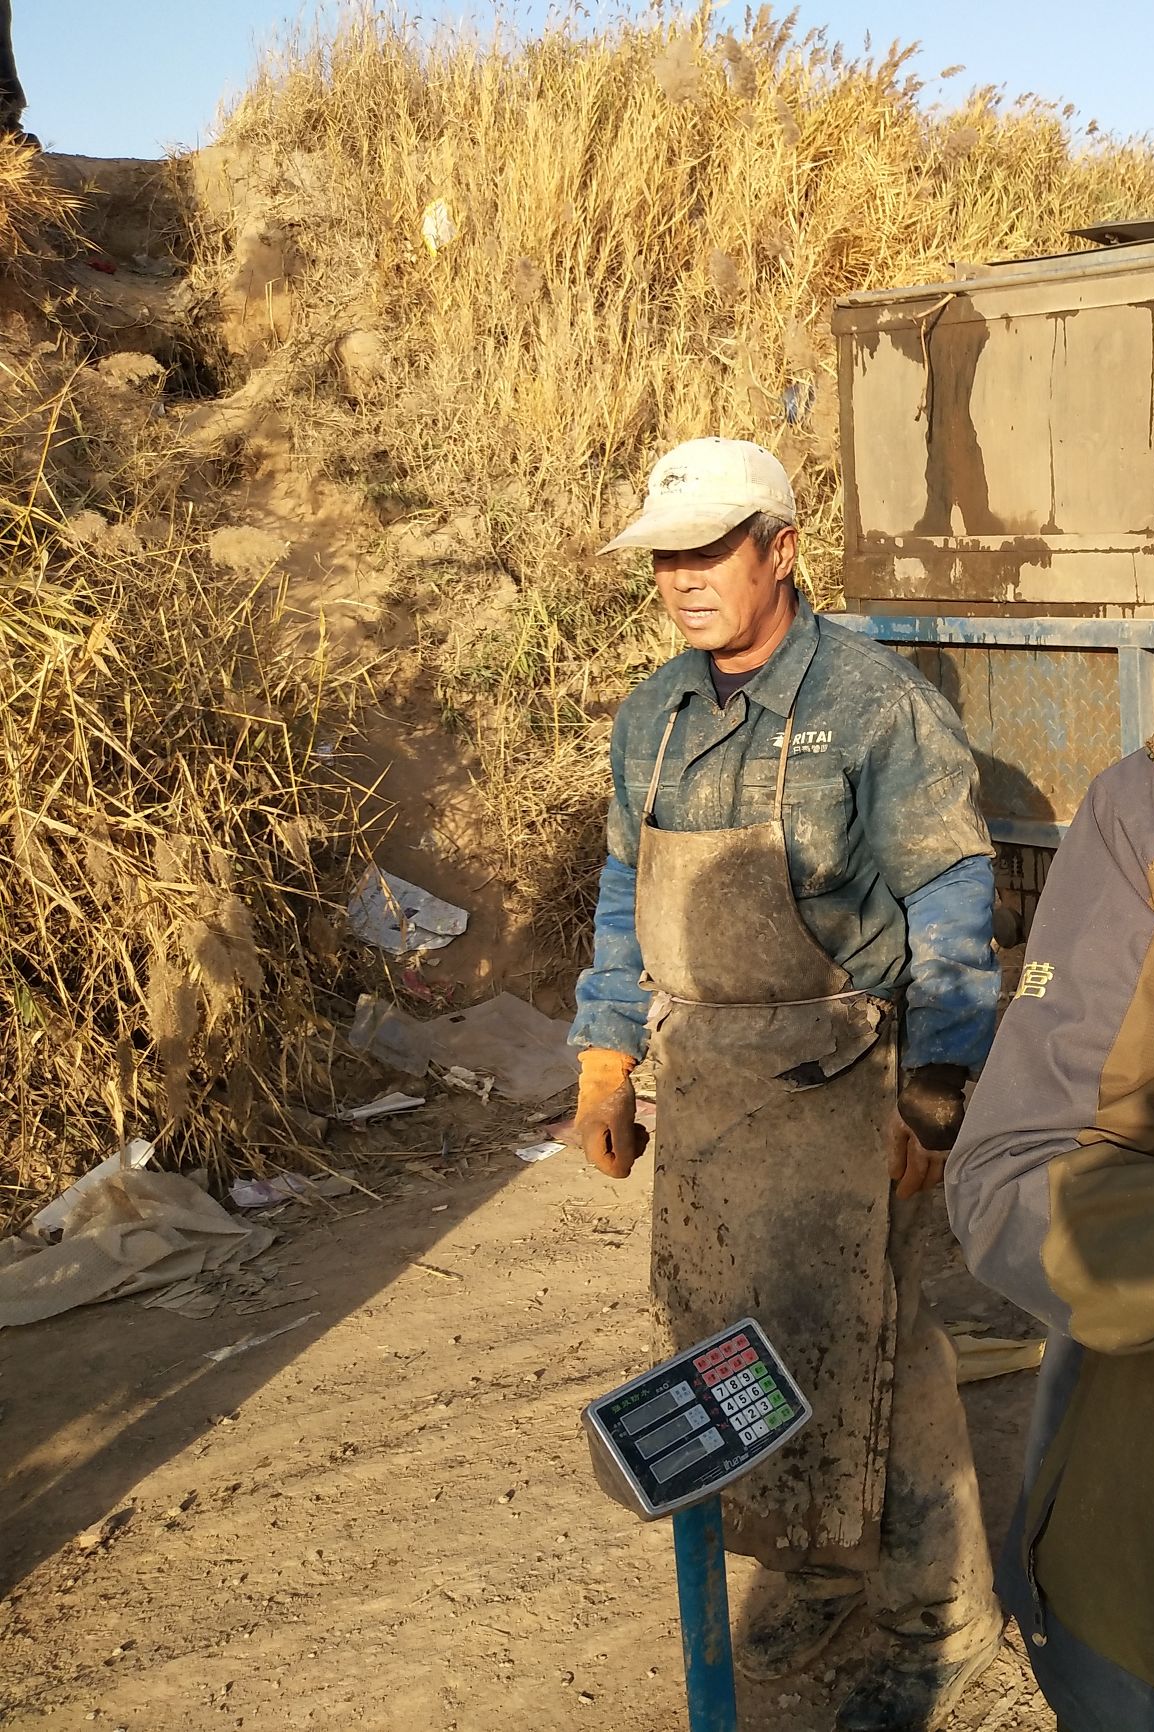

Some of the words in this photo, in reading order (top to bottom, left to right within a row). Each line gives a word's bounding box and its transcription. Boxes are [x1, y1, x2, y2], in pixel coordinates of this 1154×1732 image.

[792, 730, 833, 746] RITAI
[716, 1387, 724, 1397] 7
[729, 1379, 738, 1390] 8
[742, 1372, 751, 1382] 9
[727, 1401, 734, 1411] 4
[738, 1394, 747, 1404] 5
[751, 1386, 760, 1396] 6
[735, 1416, 743, 1426] 1
[747, 1408, 757, 1419] 2
[760, 1401, 769, 1411] 3
[744, 1431, 753, 1441] 0
